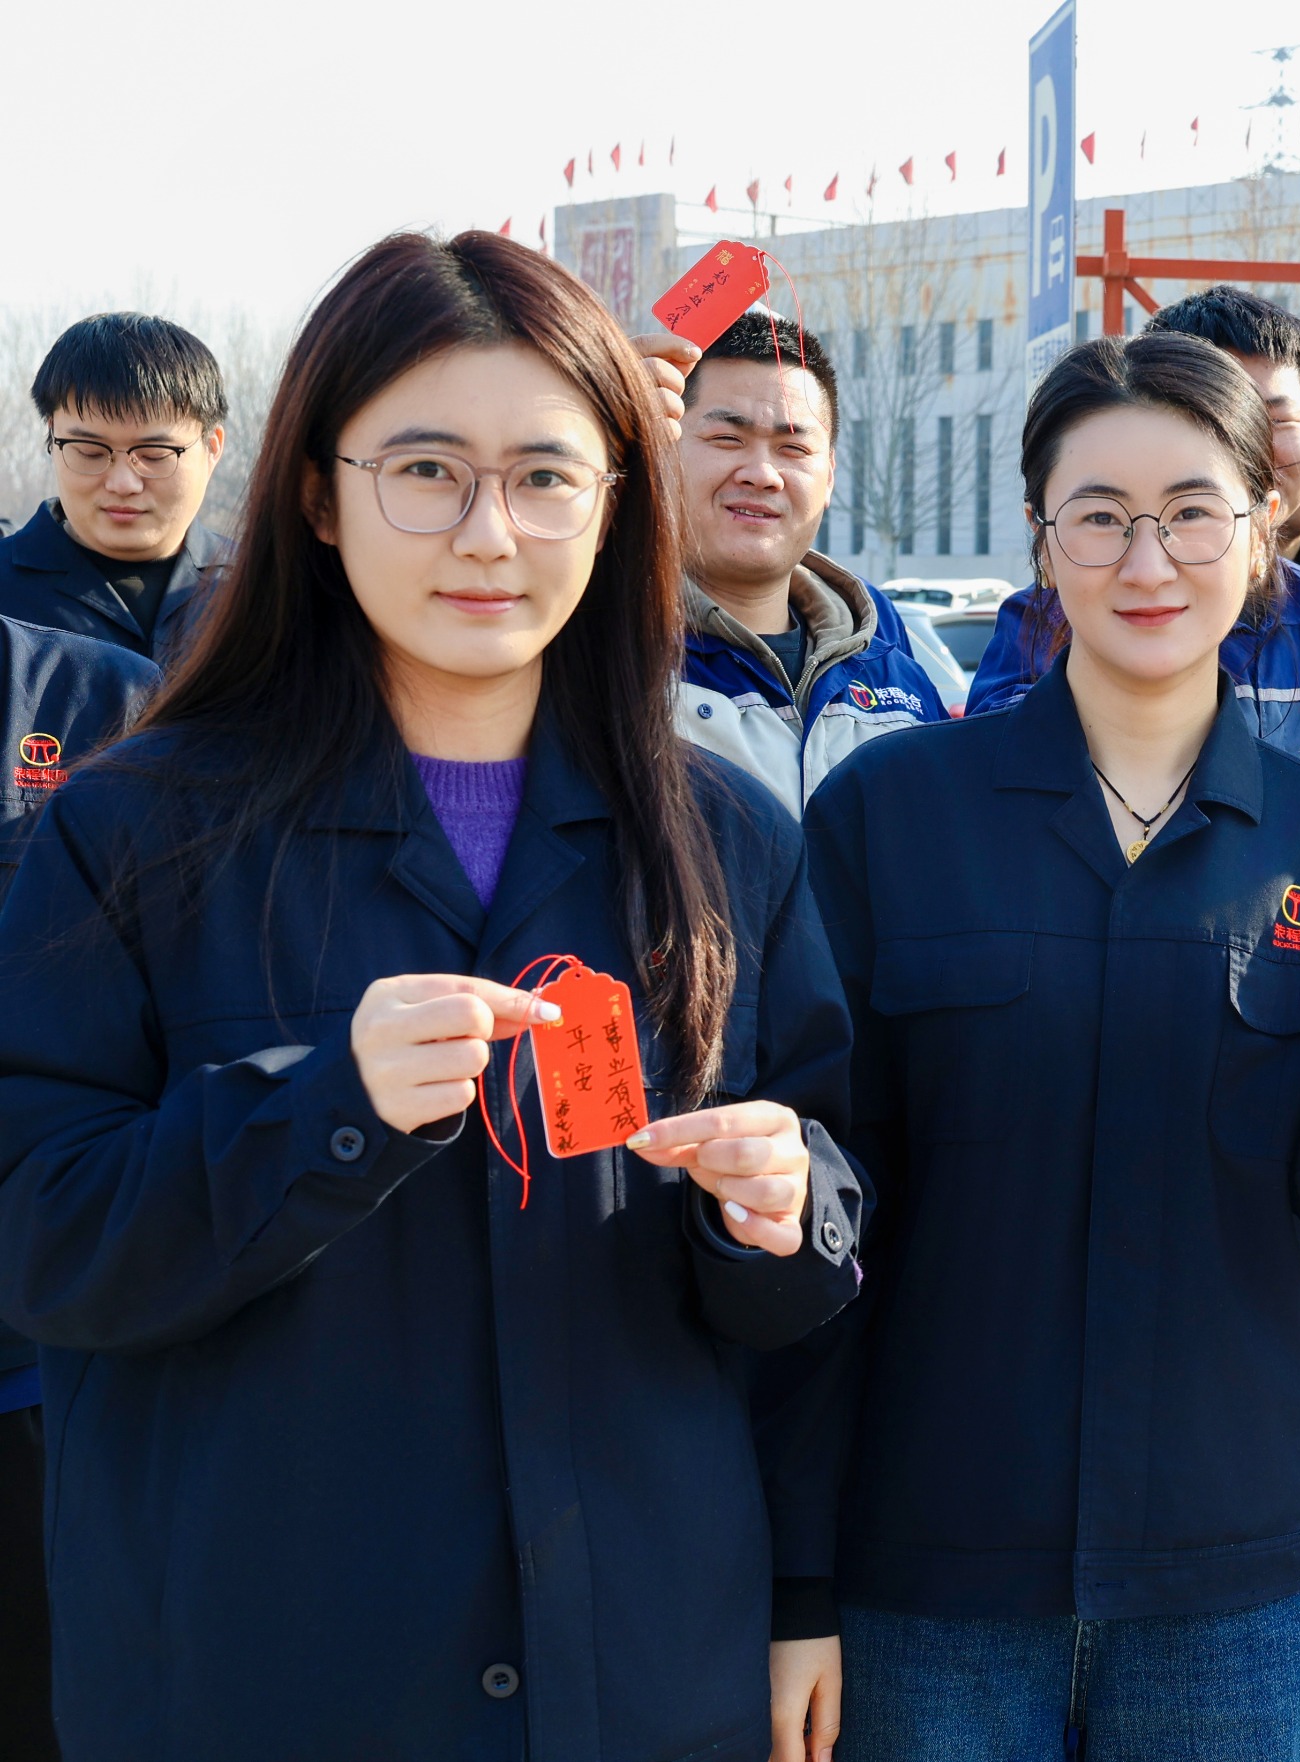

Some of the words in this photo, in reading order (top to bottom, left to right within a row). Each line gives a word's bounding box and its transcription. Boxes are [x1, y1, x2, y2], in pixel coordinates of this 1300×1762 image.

[1033, 74, 1057, 299] P
[566, 1025, 594, 1092] 平安
[602, 1017, 639, 1132] 事业有成
